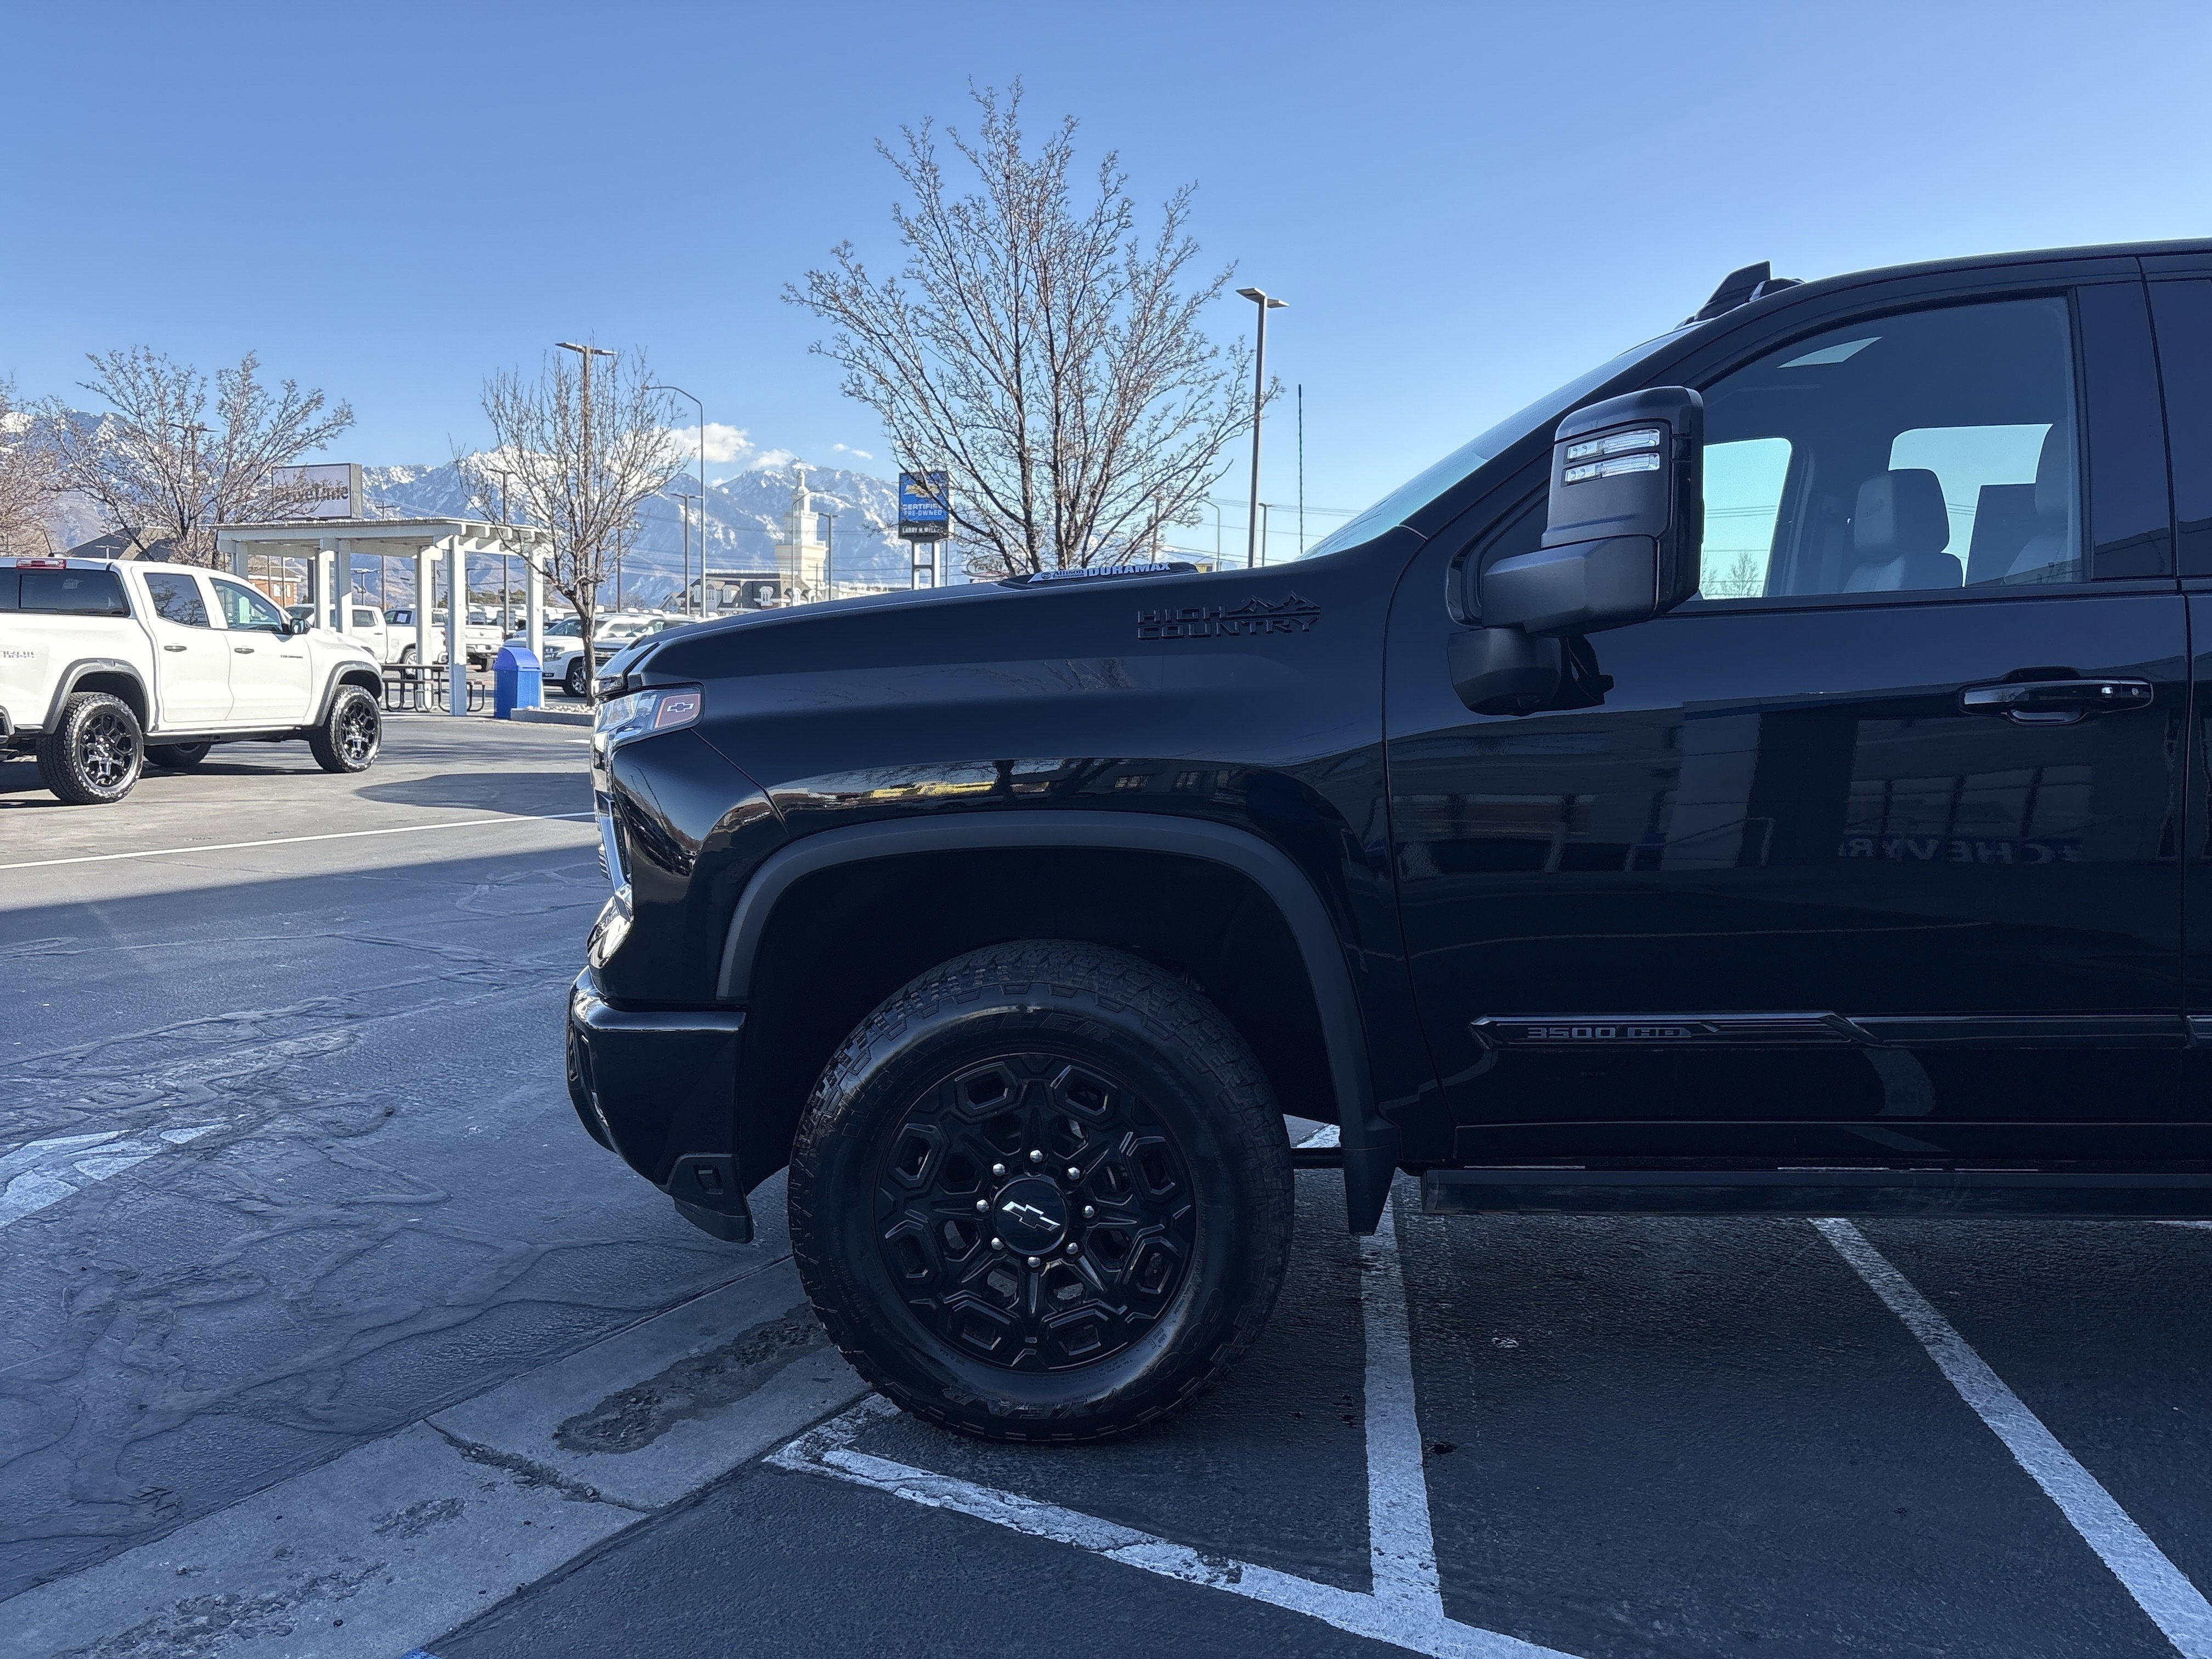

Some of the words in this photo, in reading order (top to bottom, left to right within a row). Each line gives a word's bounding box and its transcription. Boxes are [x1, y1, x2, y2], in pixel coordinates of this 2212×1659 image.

[1088, 562, 1171, 577] DURAMAX
[1137, 605, 1227, 624] HIGH
[1137, 616, 1320, 640] COUNTRY
[1527, 1026, 1616, 1039] 3500
[1627, 1026, 1692, 1039] HD
